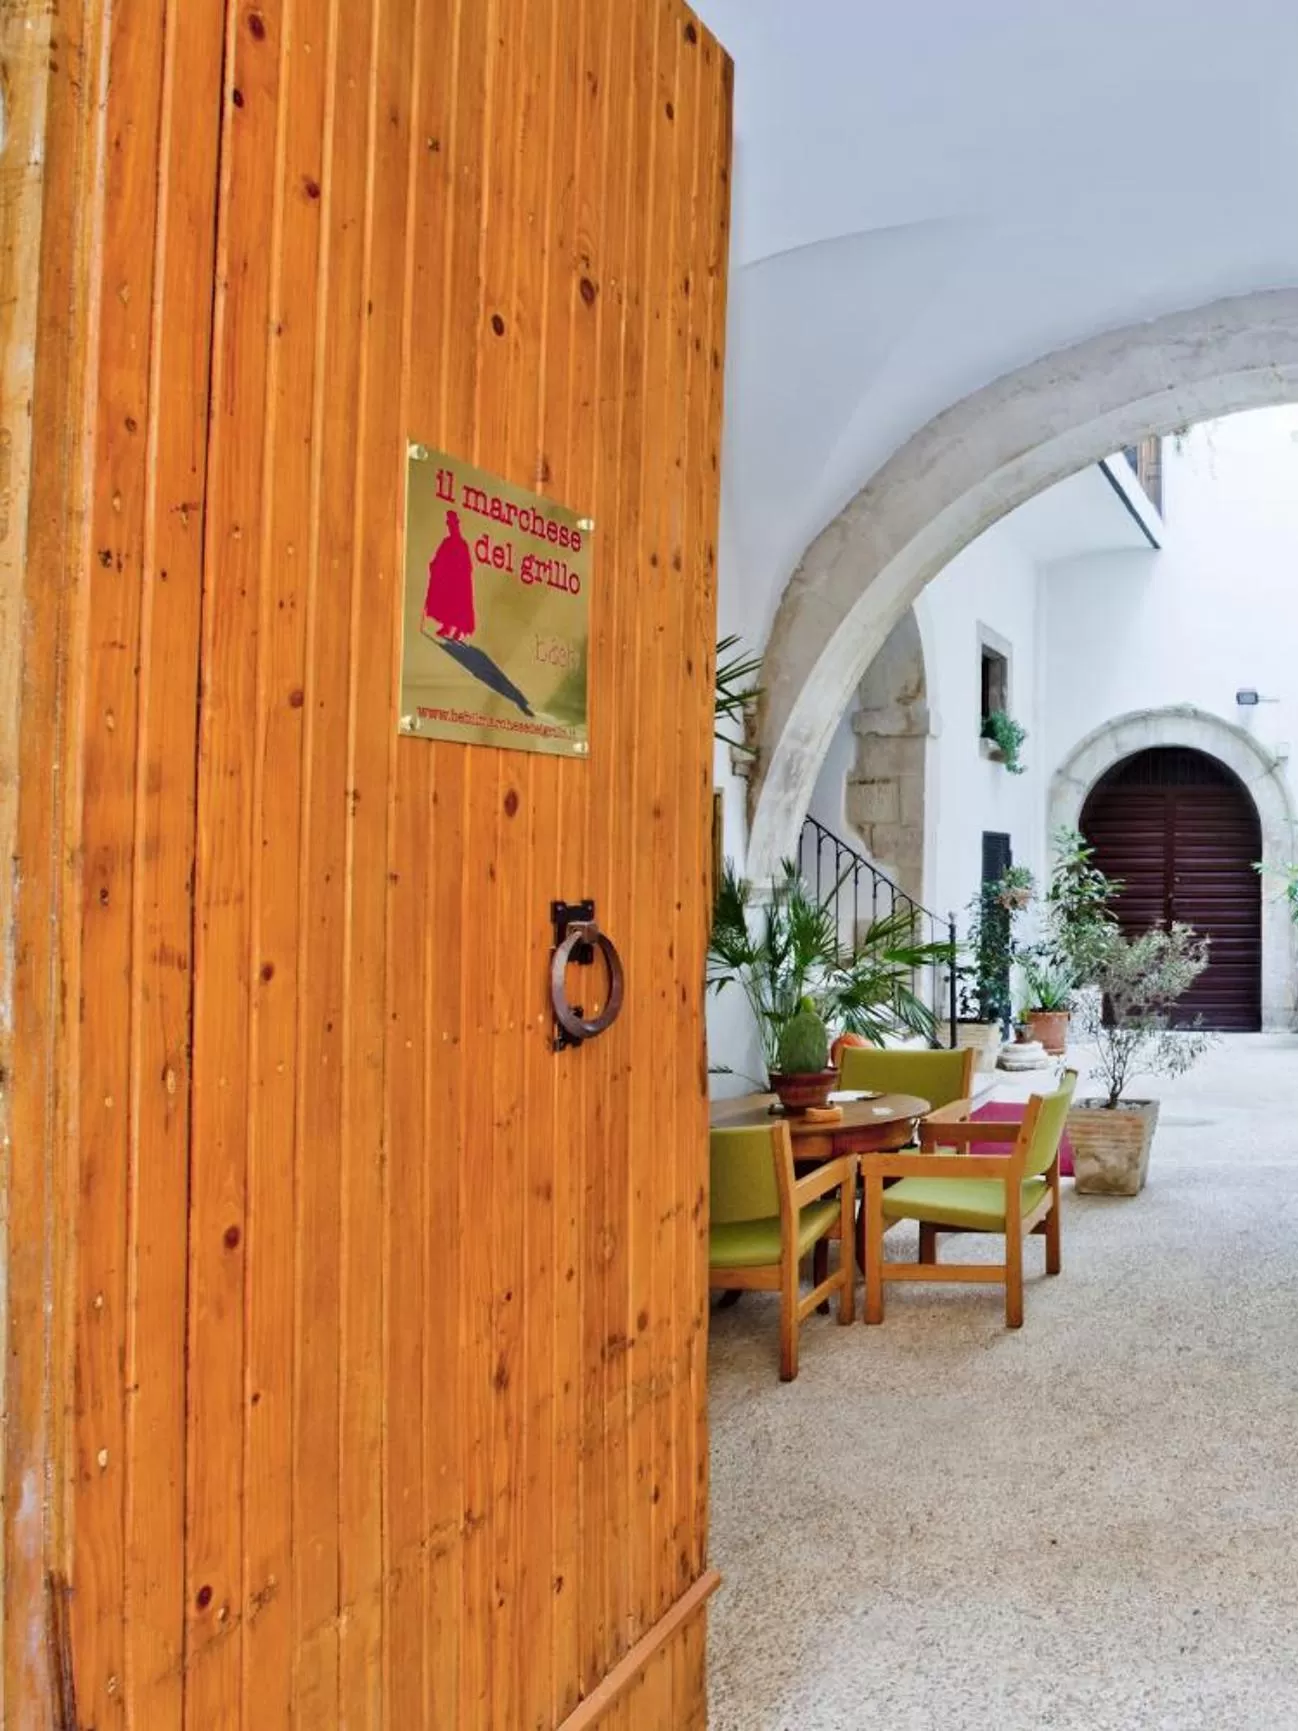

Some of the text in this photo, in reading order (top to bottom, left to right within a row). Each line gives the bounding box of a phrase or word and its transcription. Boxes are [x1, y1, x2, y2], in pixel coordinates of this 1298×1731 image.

[436, 469, 581, 552] il marchese
[474, 534, 581, 594] del grillo
